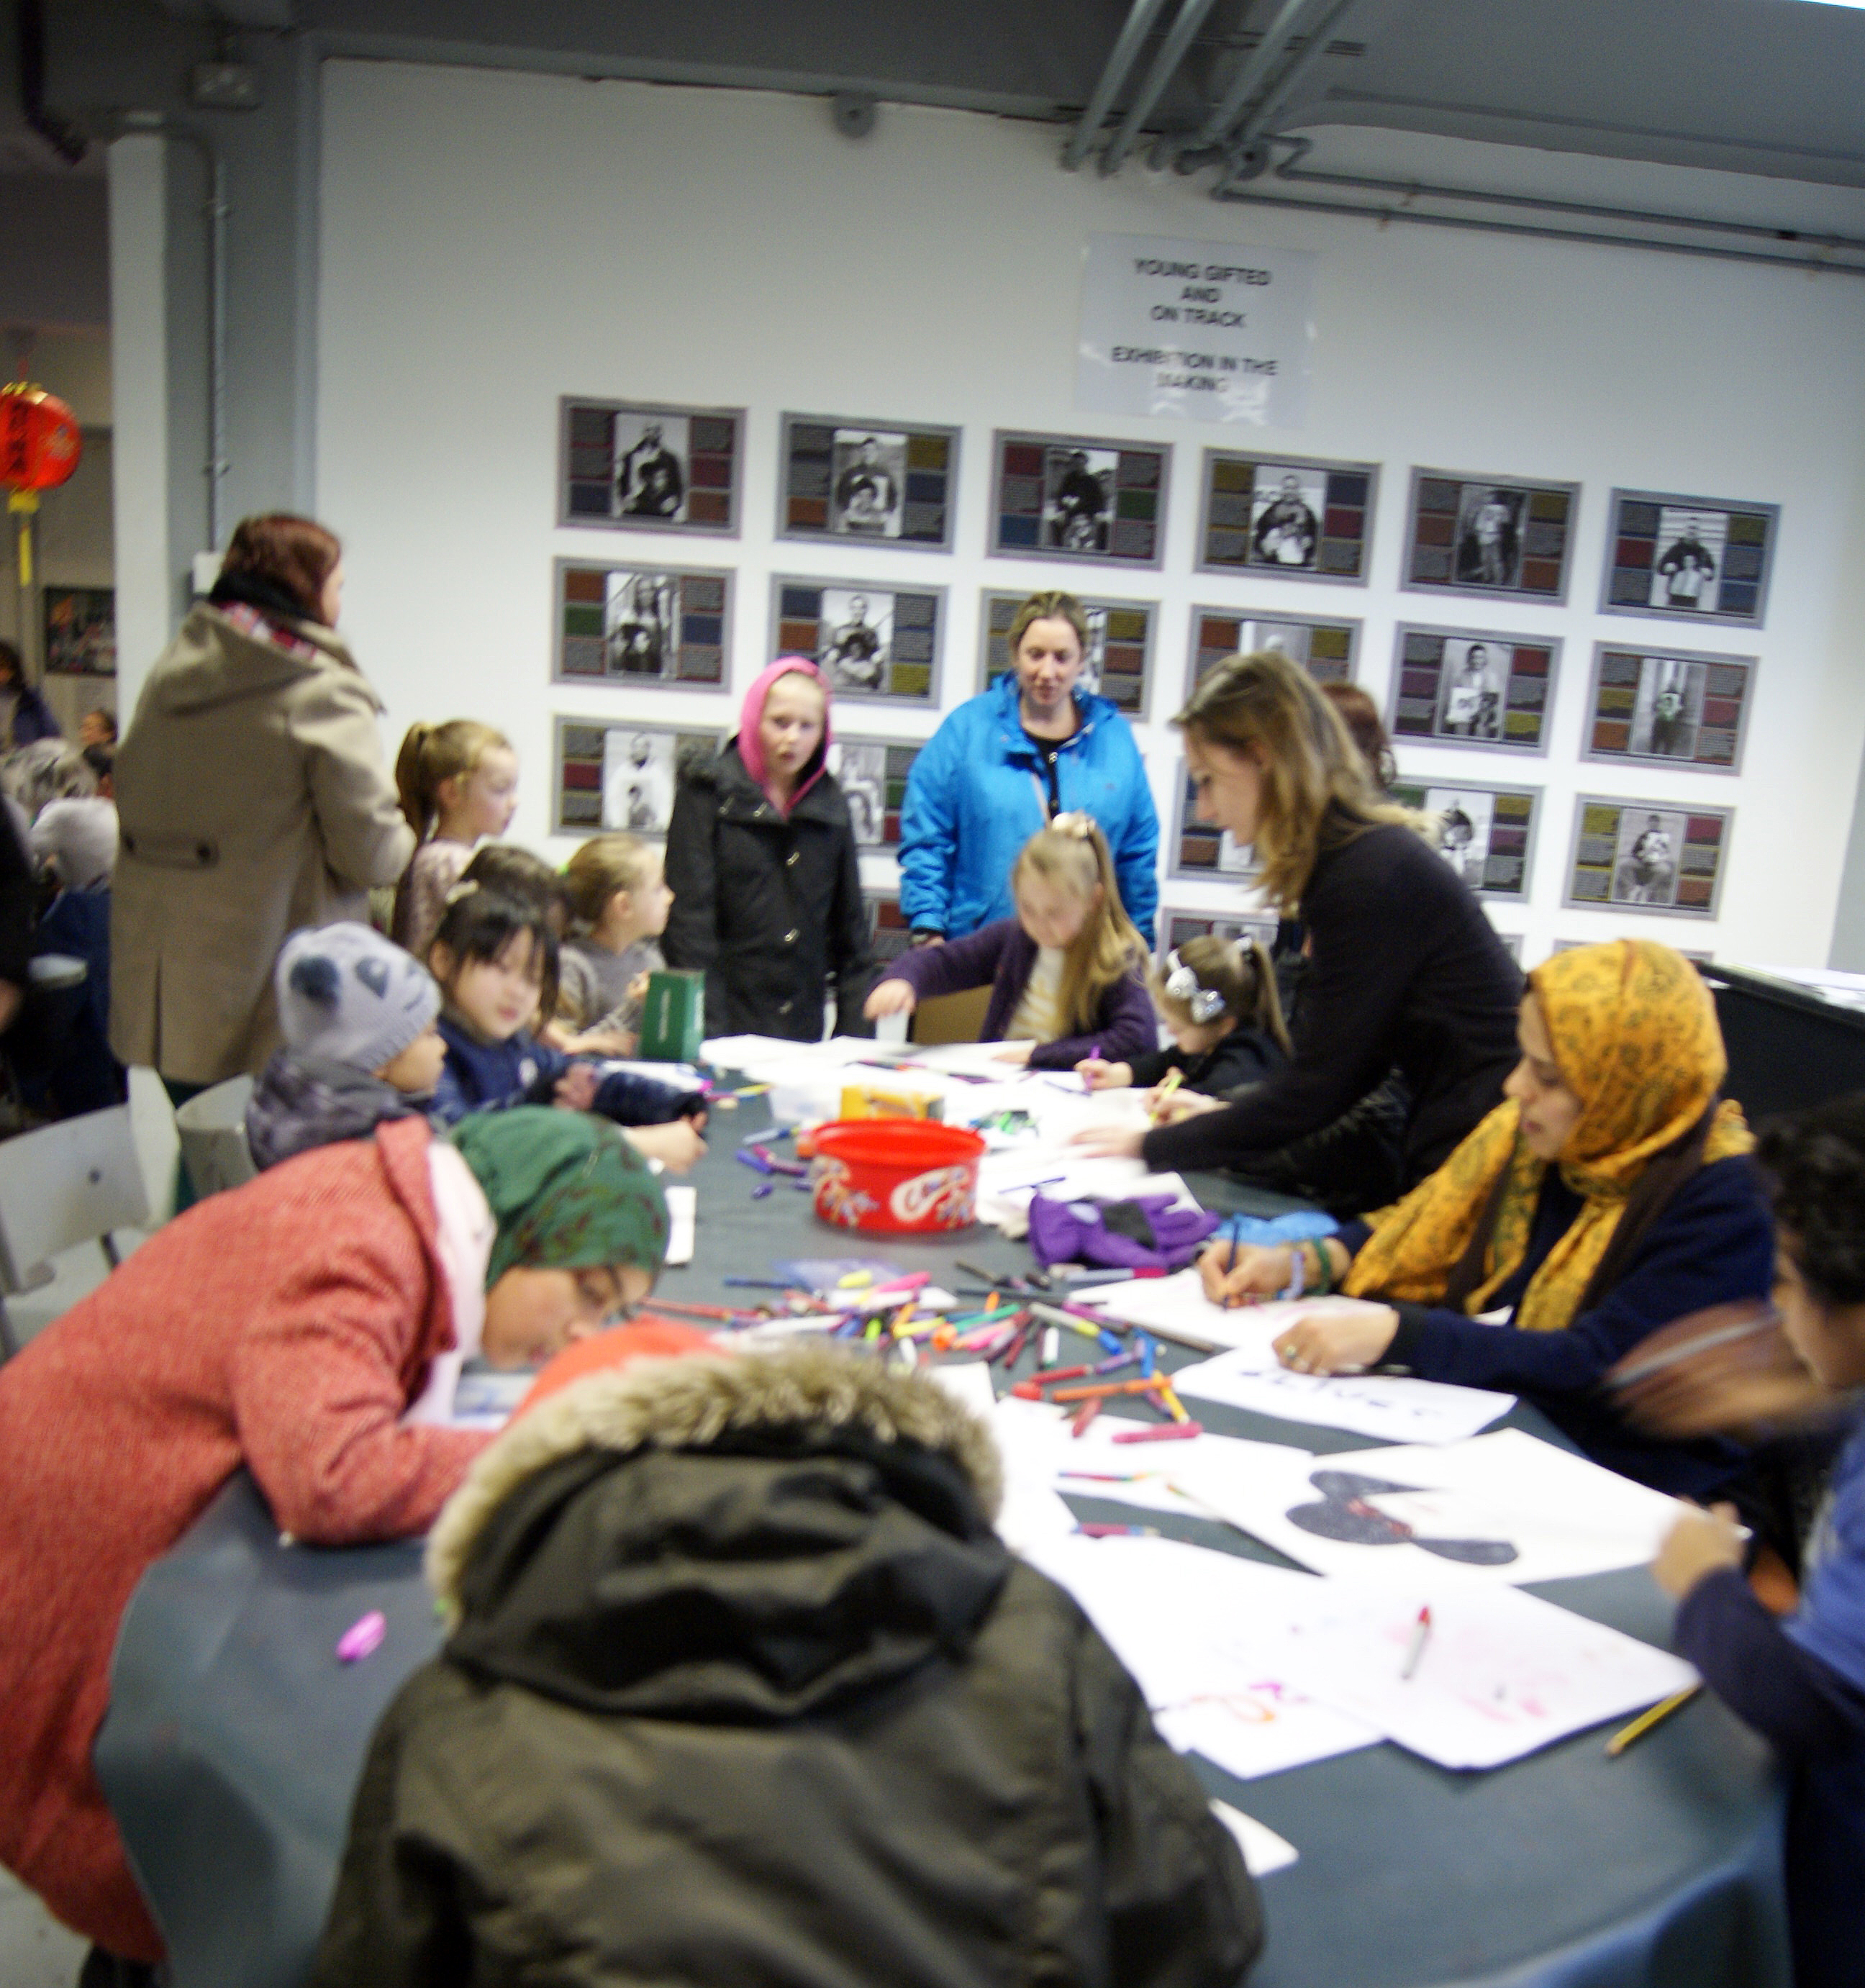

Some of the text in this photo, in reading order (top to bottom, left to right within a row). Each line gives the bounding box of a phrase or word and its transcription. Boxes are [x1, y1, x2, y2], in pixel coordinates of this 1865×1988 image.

[1135, 259, 1272, 286] YOUNG GIFTED
[1180, 286, 1221, 304] AND
[1151, 305, 1248, 327] ON TRACK
[1112, 345, 1279, 376] EXHIBION IN THE
